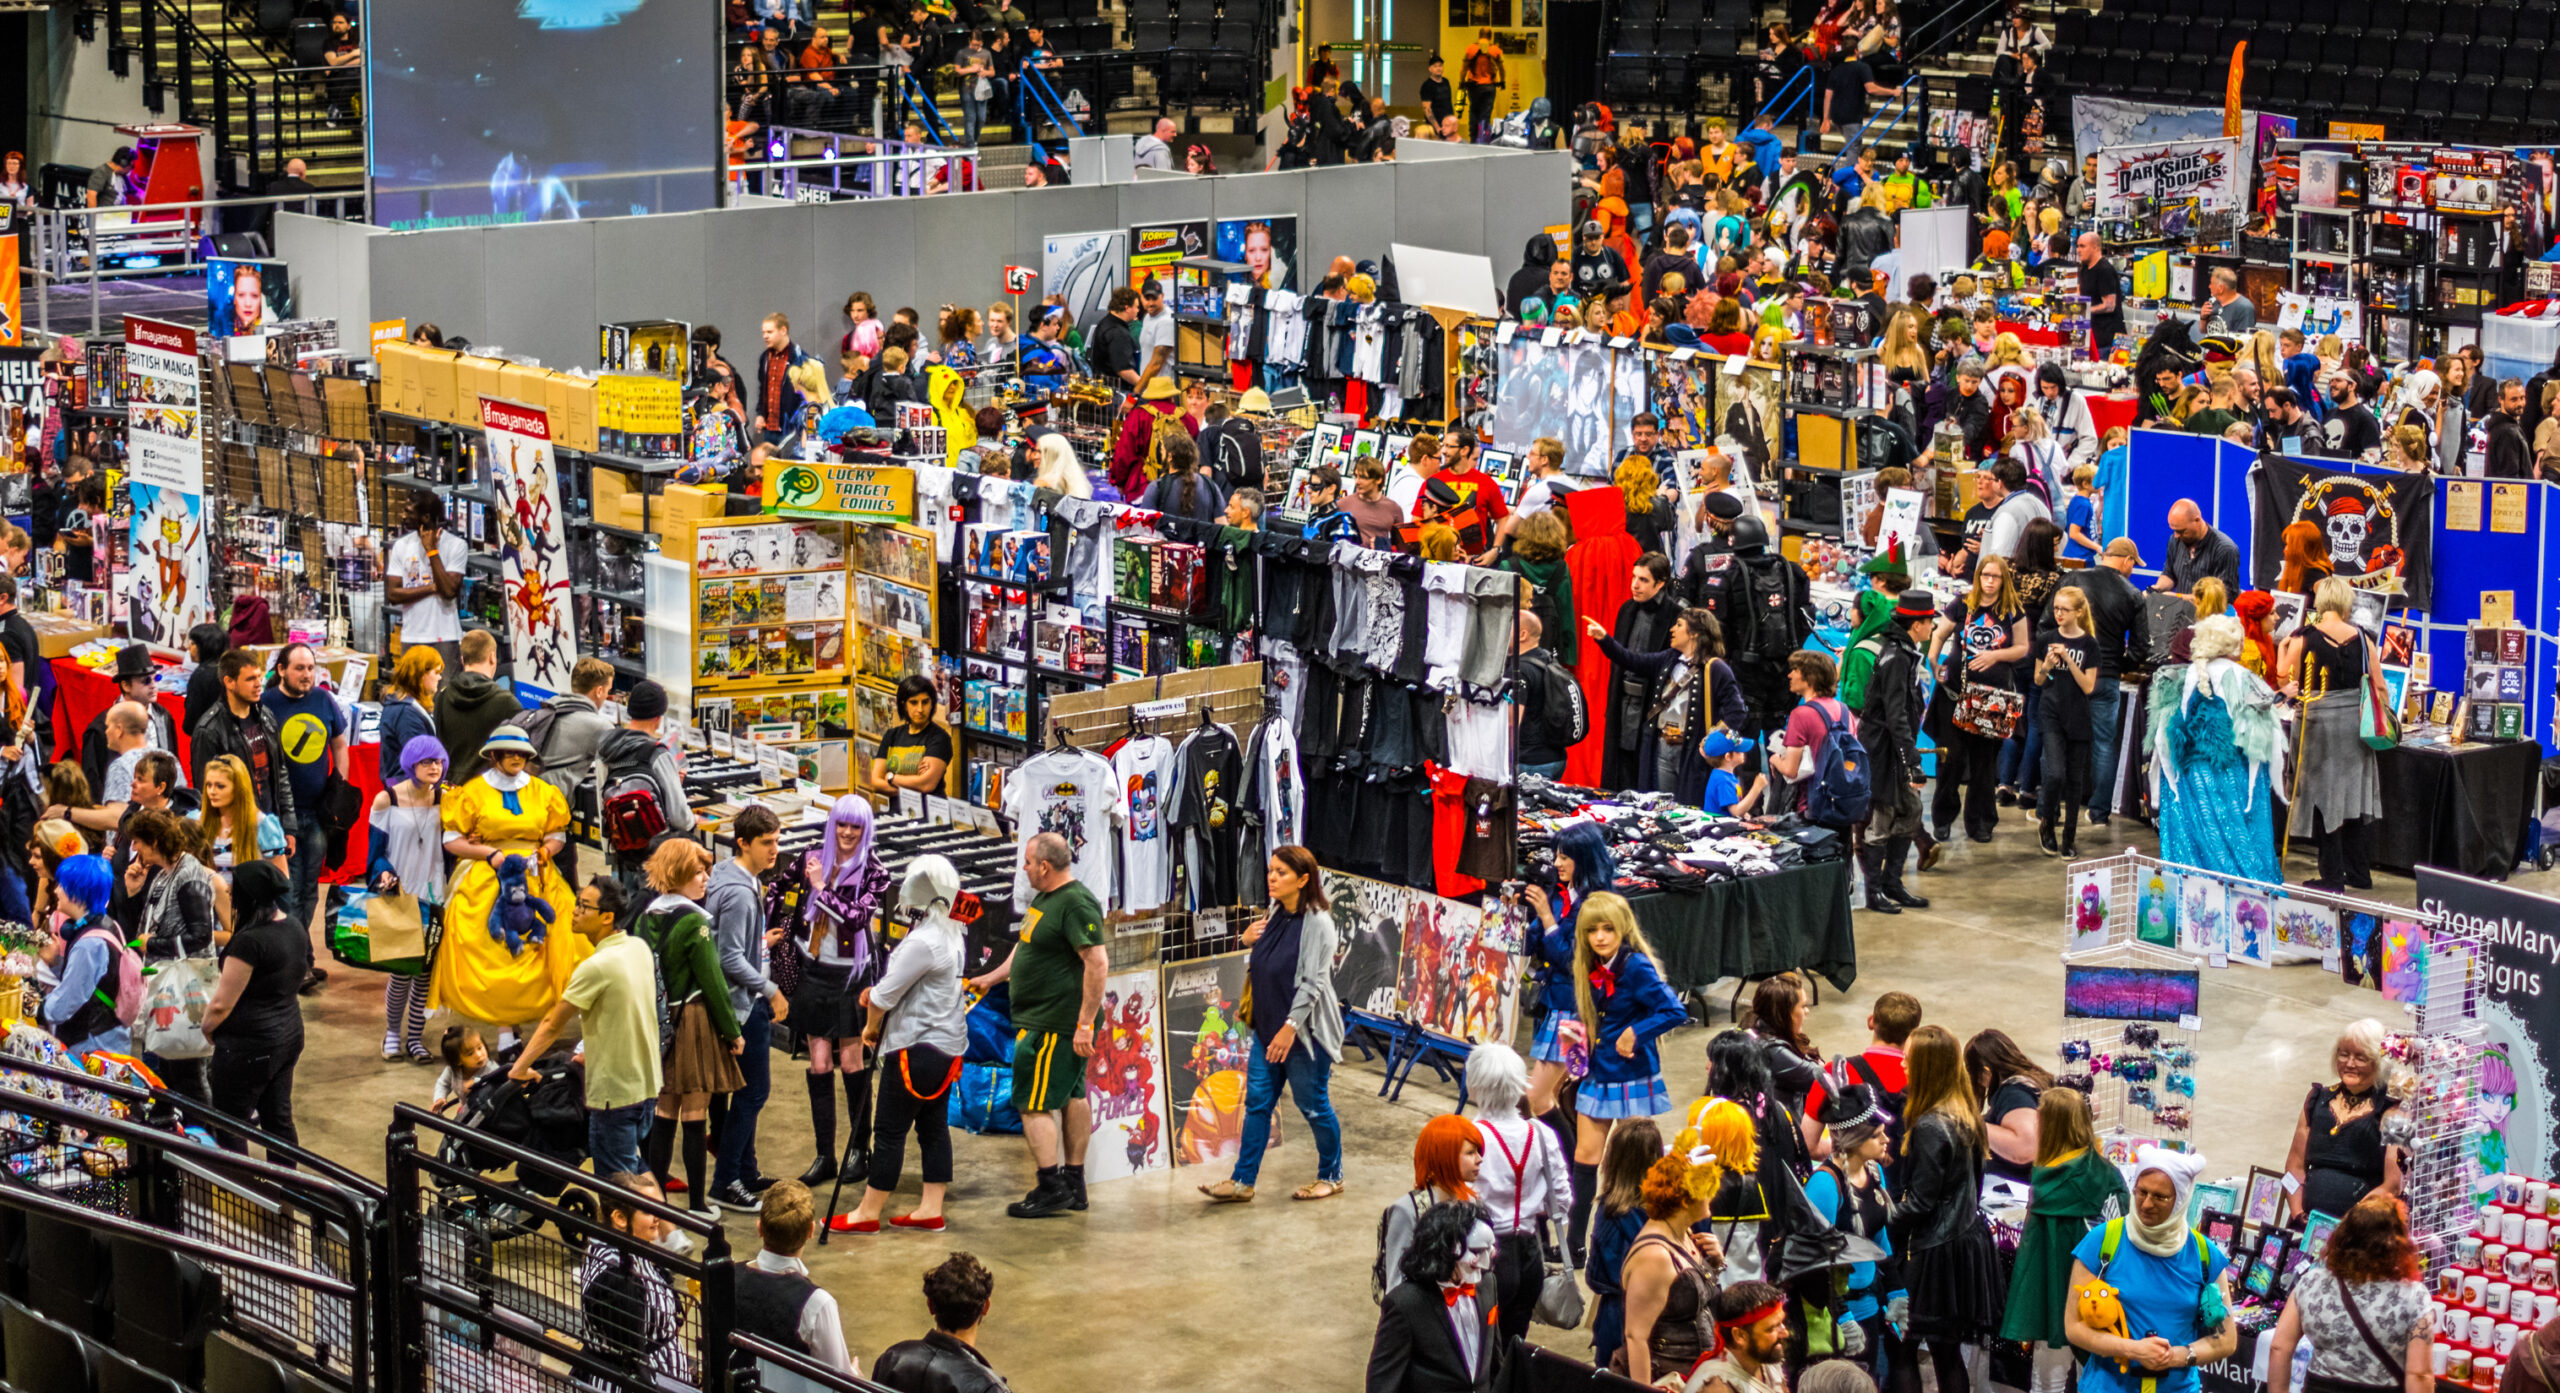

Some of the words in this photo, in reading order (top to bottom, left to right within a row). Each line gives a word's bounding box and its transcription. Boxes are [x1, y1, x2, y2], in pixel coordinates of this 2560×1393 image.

[2119, 154, 2202, 195] DARKSIDE
[2154, 164, 2223, 199] GOODIES
[141, 330, 183, 348] mayamada
[374, 326, 403, 340] MAIN
[127, 351, 161, 370] BRITISH
[163, 357, 195, 378] MANGA
[492, 410, 545, 435] mayamada
[827, 468, 876, 482] LUCKY
[835, 482, 891, 497] TARGET
[840, 497, 896, 512] COMICS
[1151, 545, 1162, 594] THOR
[2502, 679, 2520, 687] DONG
[2504, 671, 2518, 679] DING
[1147, 703, 1173, 712] T-SHIRTS
[1567, 680, 1582, 740] adidas
[1196, 912, 1223, 922] T-Shirts
[1203, 926, 1217, 935] £15
[2421, 898, 2560, 965] ShonaMary
[2475, 956, 2541, 996] signs
